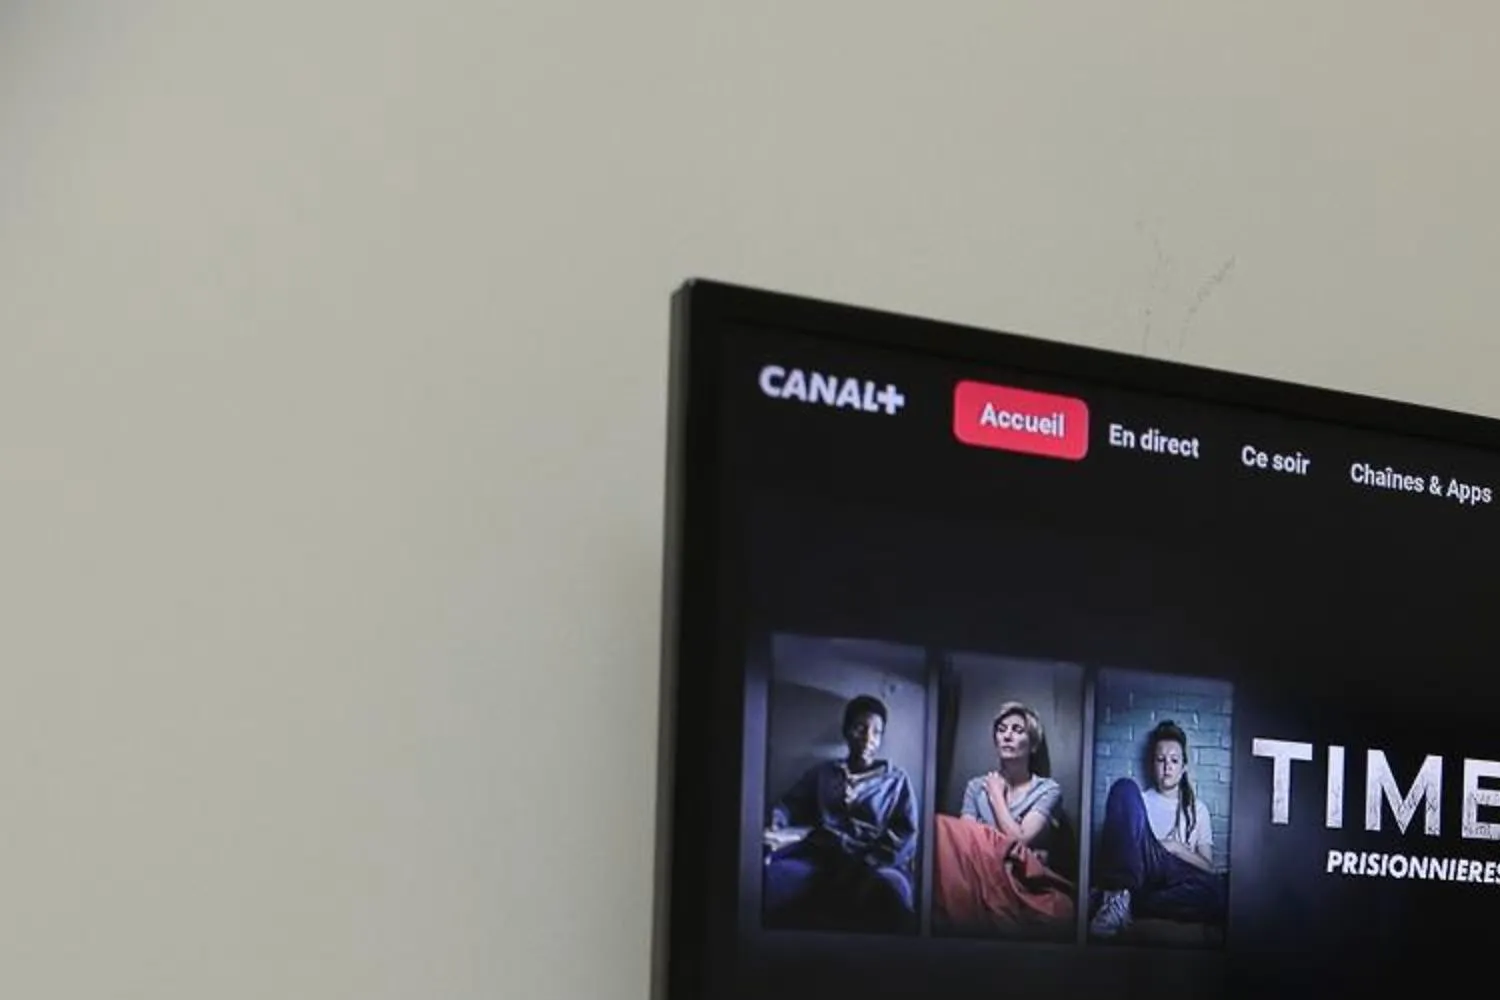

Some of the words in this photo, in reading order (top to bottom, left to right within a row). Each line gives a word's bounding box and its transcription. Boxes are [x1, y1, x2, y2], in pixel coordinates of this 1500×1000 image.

[759, 365, 904, 415] CANAL+
[979, 402, 1065, 438] Accueil
[1109, 424, 1135, 449] En
[1140, 428, 1200, 458] direct
[1241, 445, 1268, 469] Ce
[1272, 452, 1311, 476] soir
[1350, 462, 1425, 494] Chaînes
[1428, 475, 1443, 496] &
[1447, 479, 1492, 505] Apps
